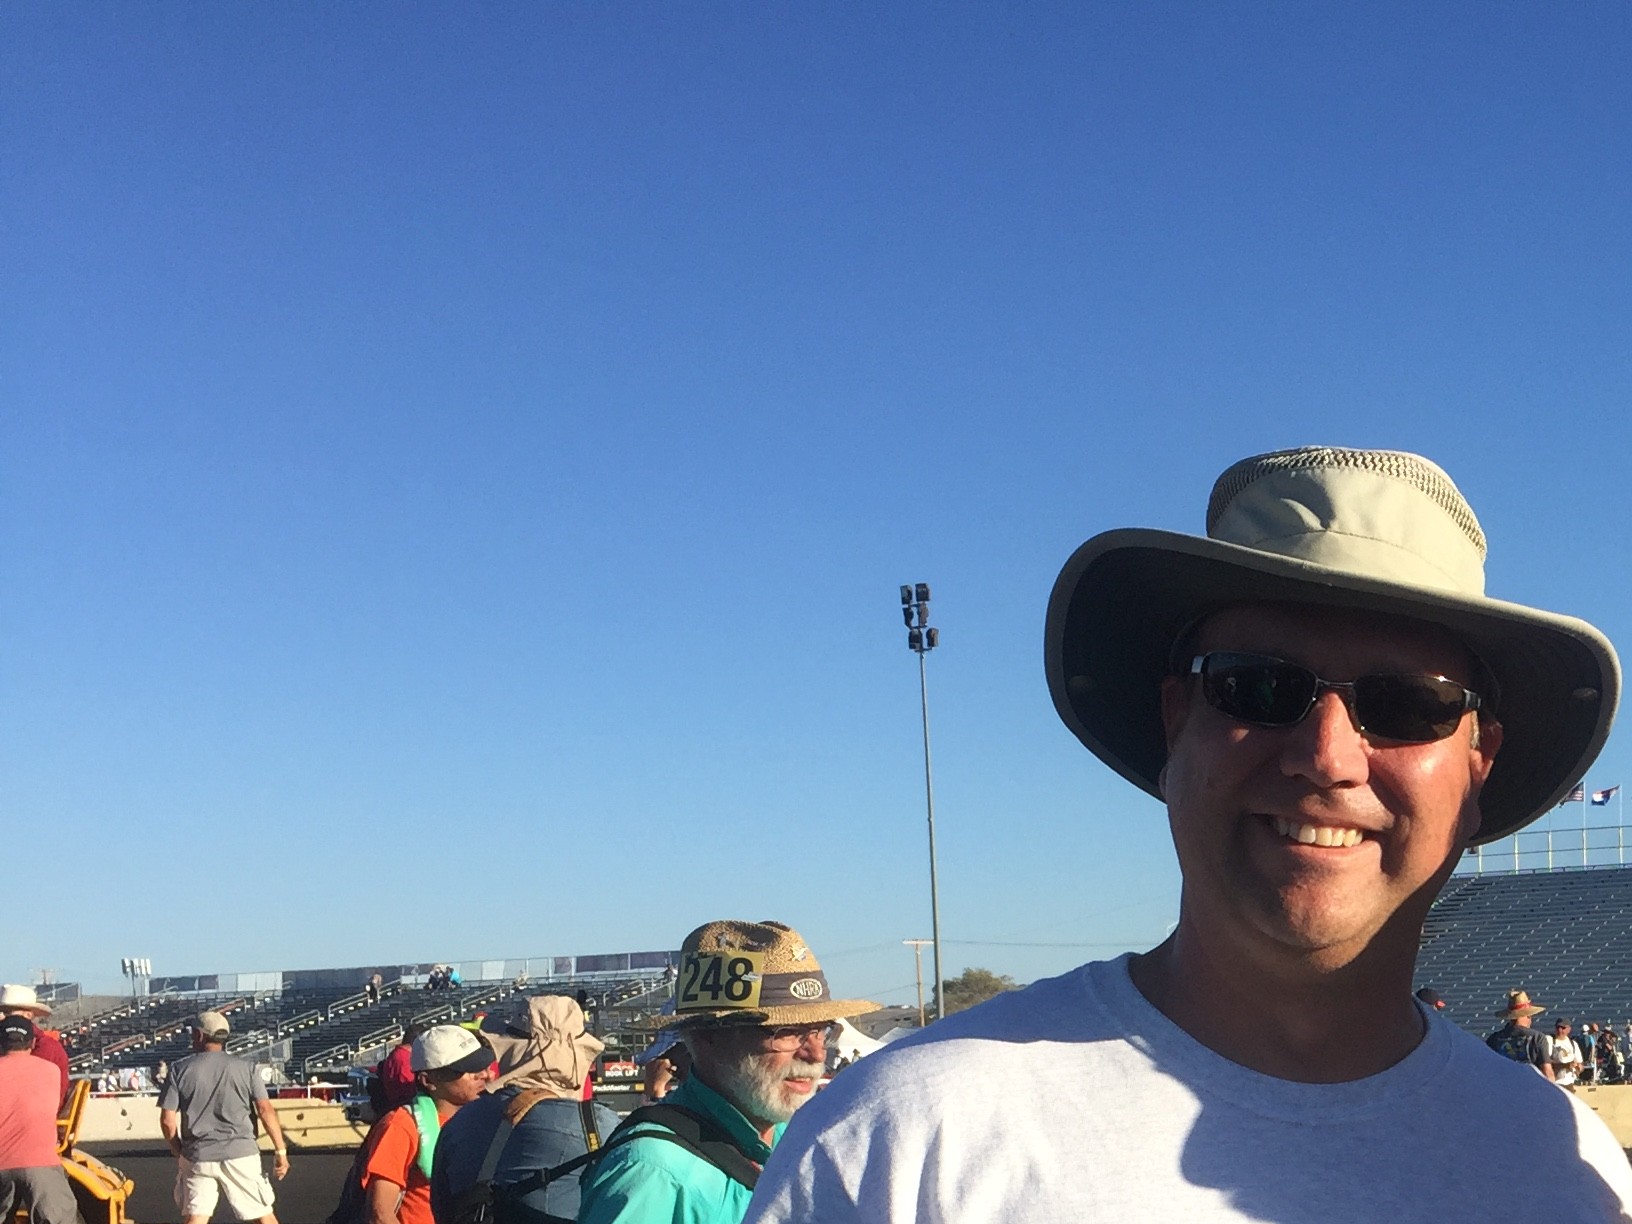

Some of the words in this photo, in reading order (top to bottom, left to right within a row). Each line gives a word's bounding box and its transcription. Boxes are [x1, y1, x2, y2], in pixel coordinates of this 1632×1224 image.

[682, 955, 754, 1002] 248
[795, 981, 820, 997] NHRA
[625, 1069, 639, 1077] LIFT
